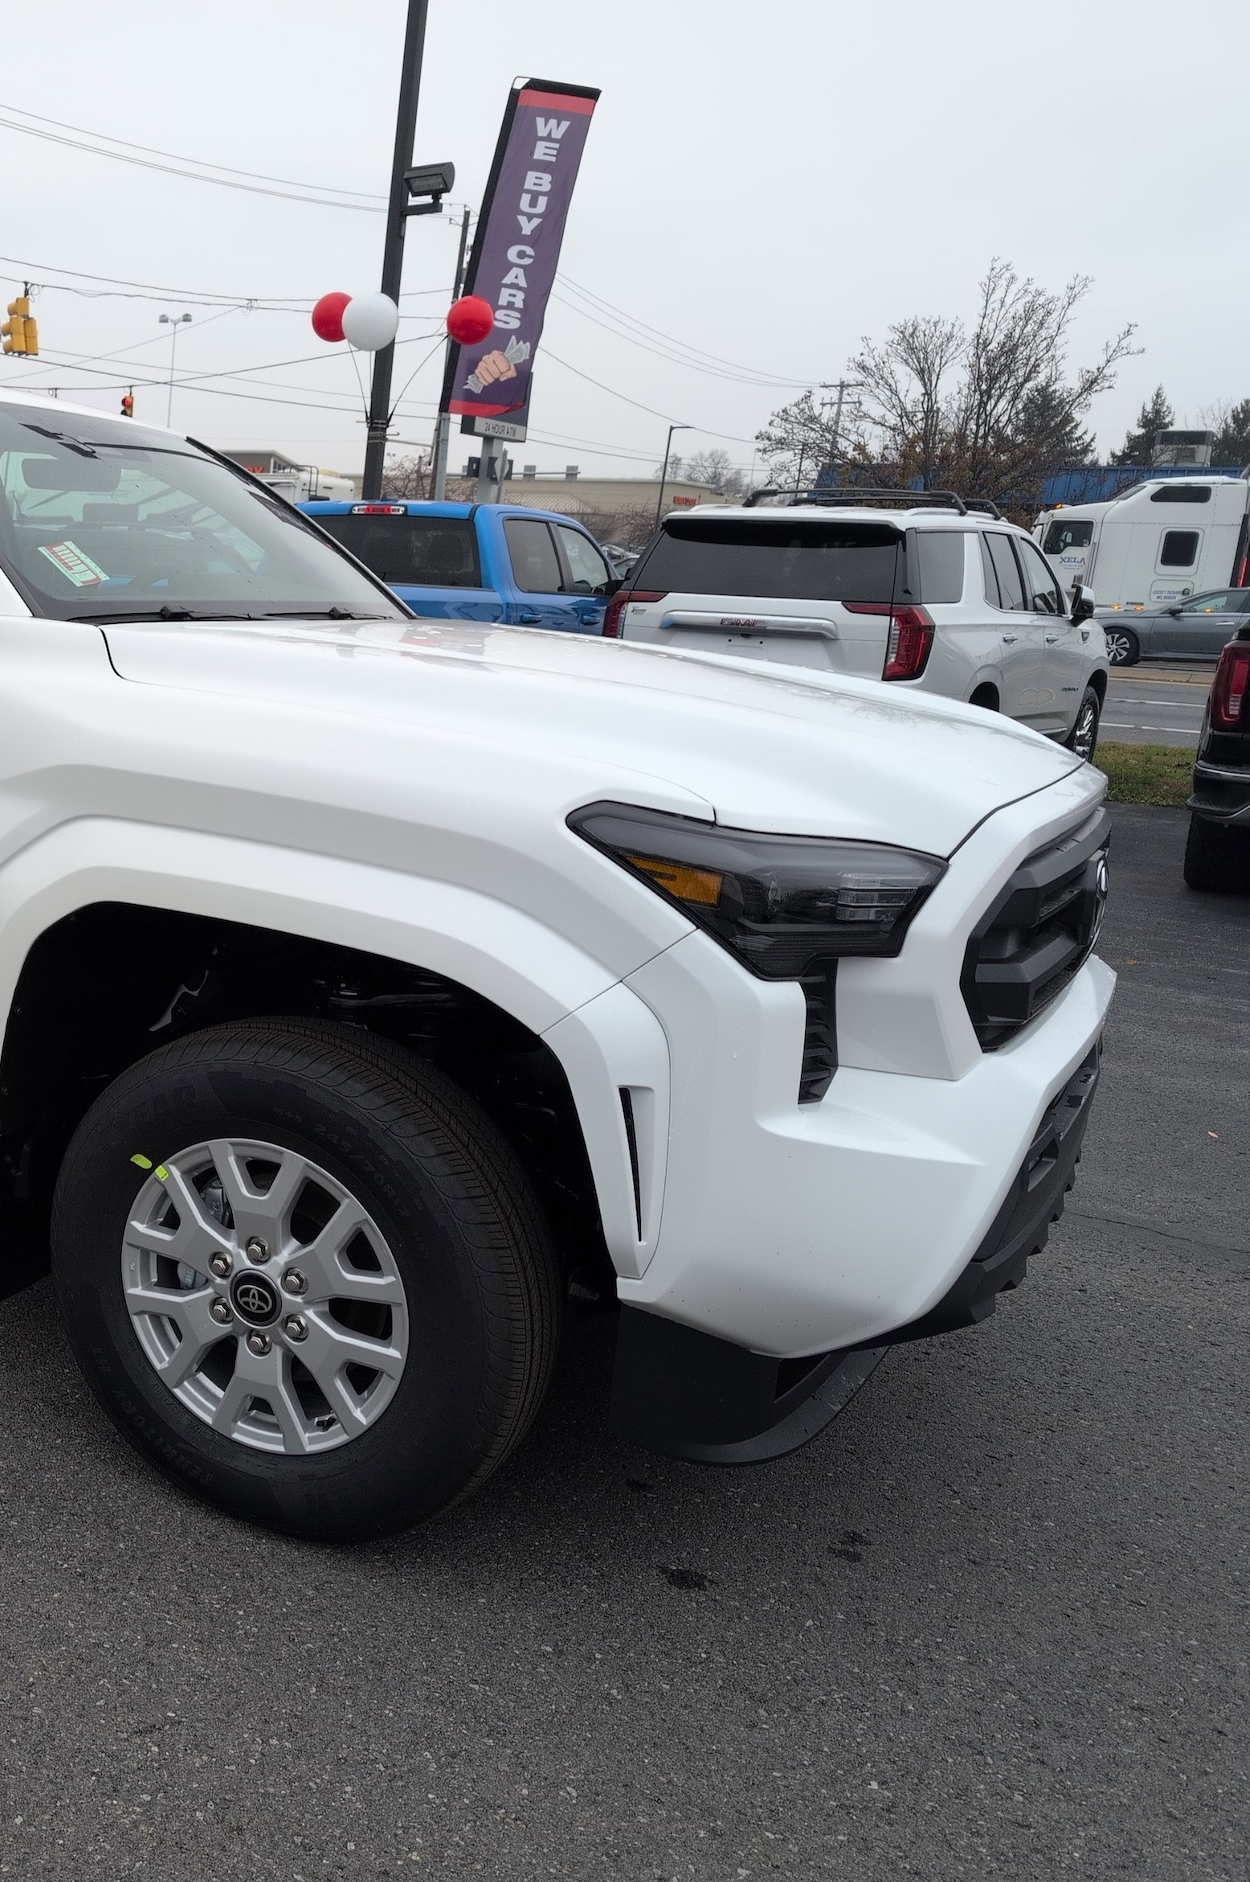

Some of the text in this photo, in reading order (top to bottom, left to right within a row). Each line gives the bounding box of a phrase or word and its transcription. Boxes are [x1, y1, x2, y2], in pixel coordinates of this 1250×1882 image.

[493, 116, 571, 330] WE BUY CARS
[491, 423, 506, 435] HOUR
[1059, 555, 1086, 566] XELA
[720, 617, 768, 628] GMC
